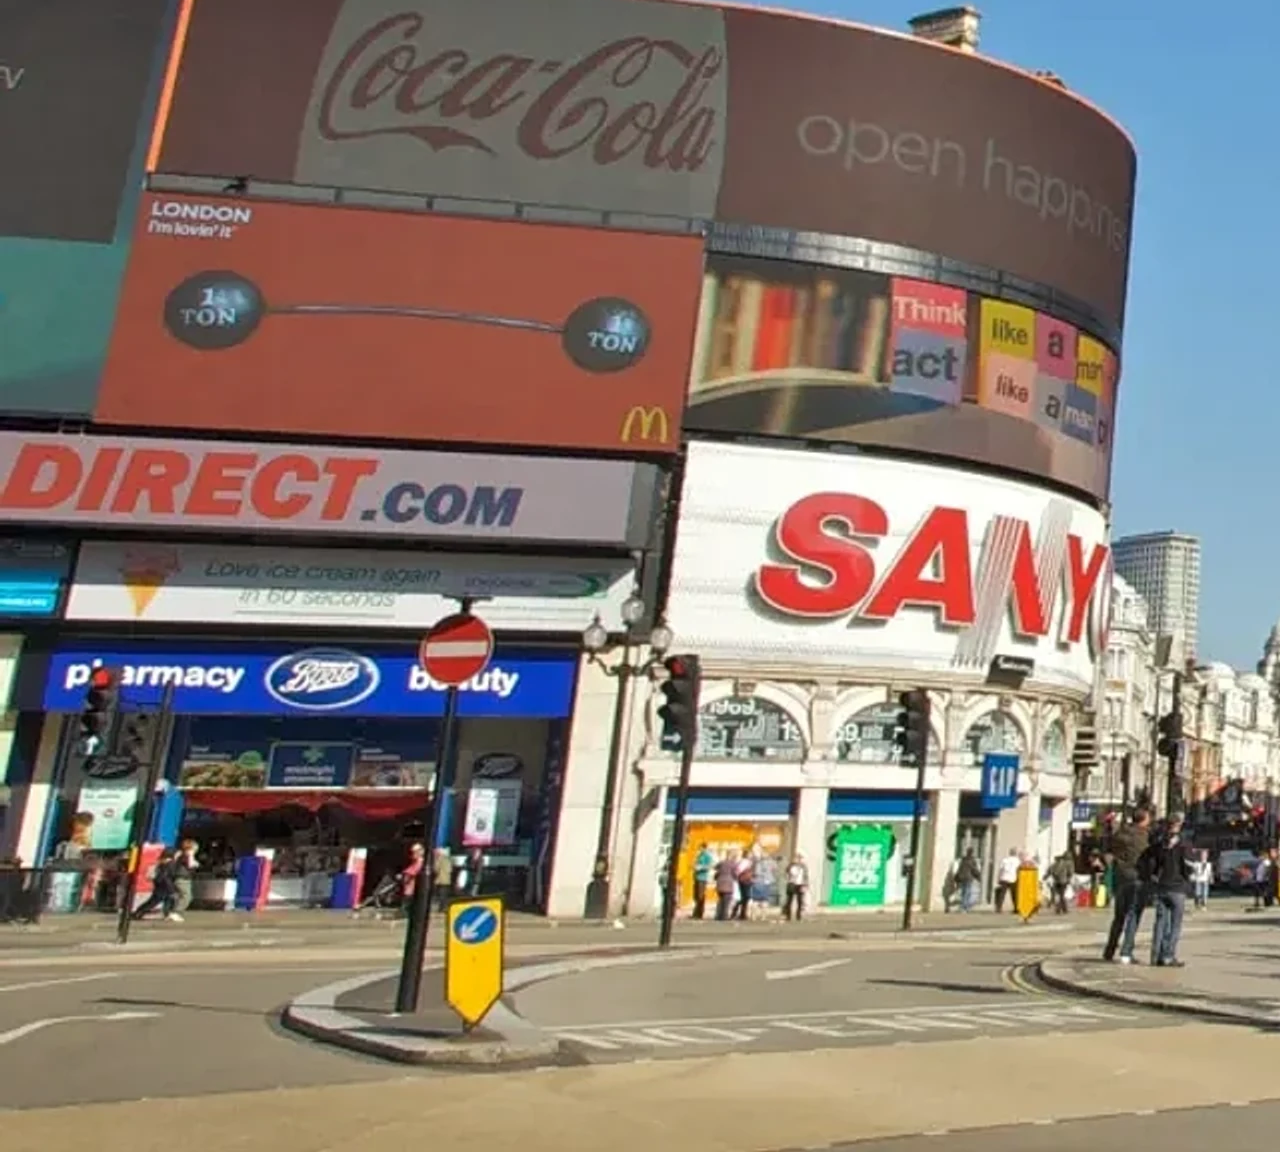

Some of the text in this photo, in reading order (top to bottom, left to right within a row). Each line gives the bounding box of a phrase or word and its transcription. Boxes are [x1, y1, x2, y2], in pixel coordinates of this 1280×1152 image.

[317, 11, 724, 172] Coca-Cola
[798, 114, 968, 189] open
[151, 201, 252, 223] LONDON
[178, 307, 236, 326] TON
[893, 294, 966, 326] Think
[586, 330, 637, 353] TON
[991, 317, 1028, 346] like
[1048, 331, 1064, 359] a
[893, 345, 958, 382] act
[996, 374, 1030, 404] like
[1044, 394, 1061, 420] a
[204, 562, 441, 586] Love ice cream again
[266, 587, 298, 606] 60
[64, 658, 245, 694] parmacy
